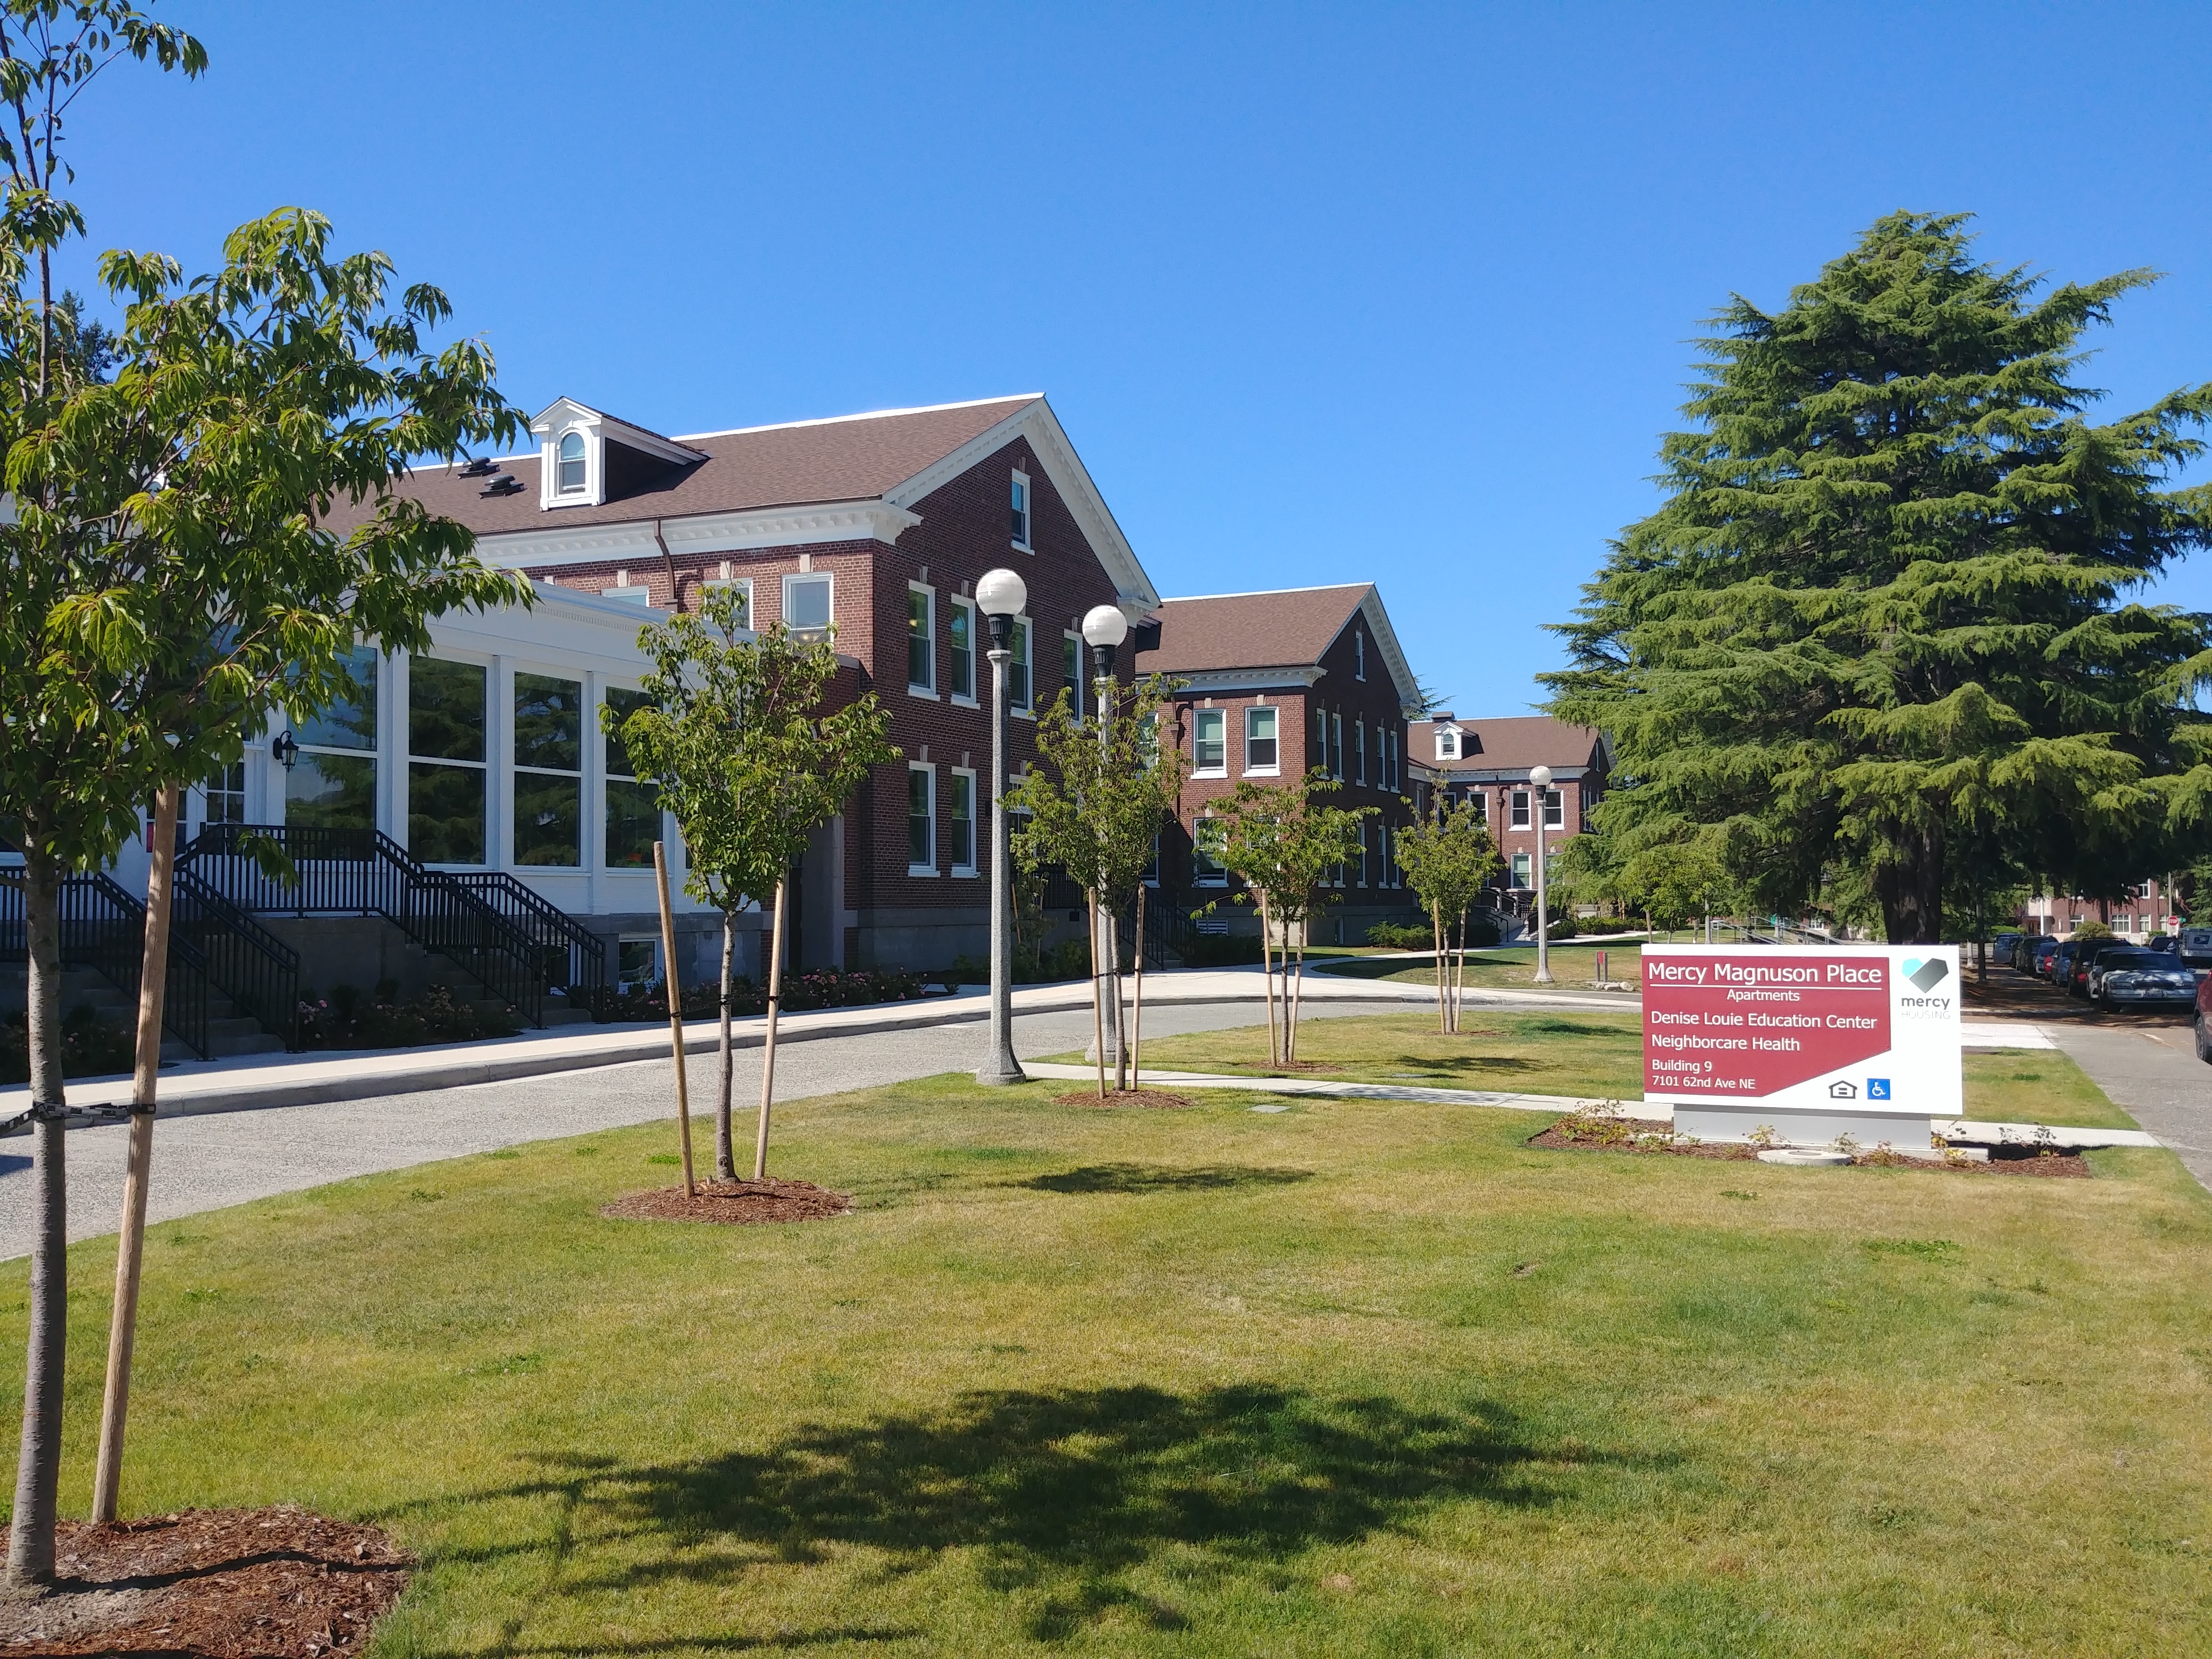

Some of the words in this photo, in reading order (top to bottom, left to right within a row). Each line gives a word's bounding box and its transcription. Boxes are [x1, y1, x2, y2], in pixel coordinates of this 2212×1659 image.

[1649, 963, 1707, 984] Mercy
[1714, 963, 1819, 985] Magnuson
[1827, 965, 1882, 983] Place
[1727, 989, 1800, 1003] Apartments
[1901, 998, 1950, 1010] mercy
[1651, 1011, 1699, 1025] Denise
[1704, 1012, 1744, 1026] Louie
[1748, 1013, 1821, 1028] Education
[1826, 1015, 1878, 1029] Center
[1901, 1010, 1950, 1019] HOUSING
[1652, 1034, 1748, 1051] Neighborcare
[1752, 1037, 1800, 1051] Health
[1652, 1059, 1700, 1074] Building
[1704, 1061, 1712, 1072] 9
[1652, 1076, 1680, 1086] 7101
[1683, 1077, 1711, 1087] 62nd
[1714, 1078, 1736, 1088] Ave
[1739, 1079, 1756, 1090] NE
